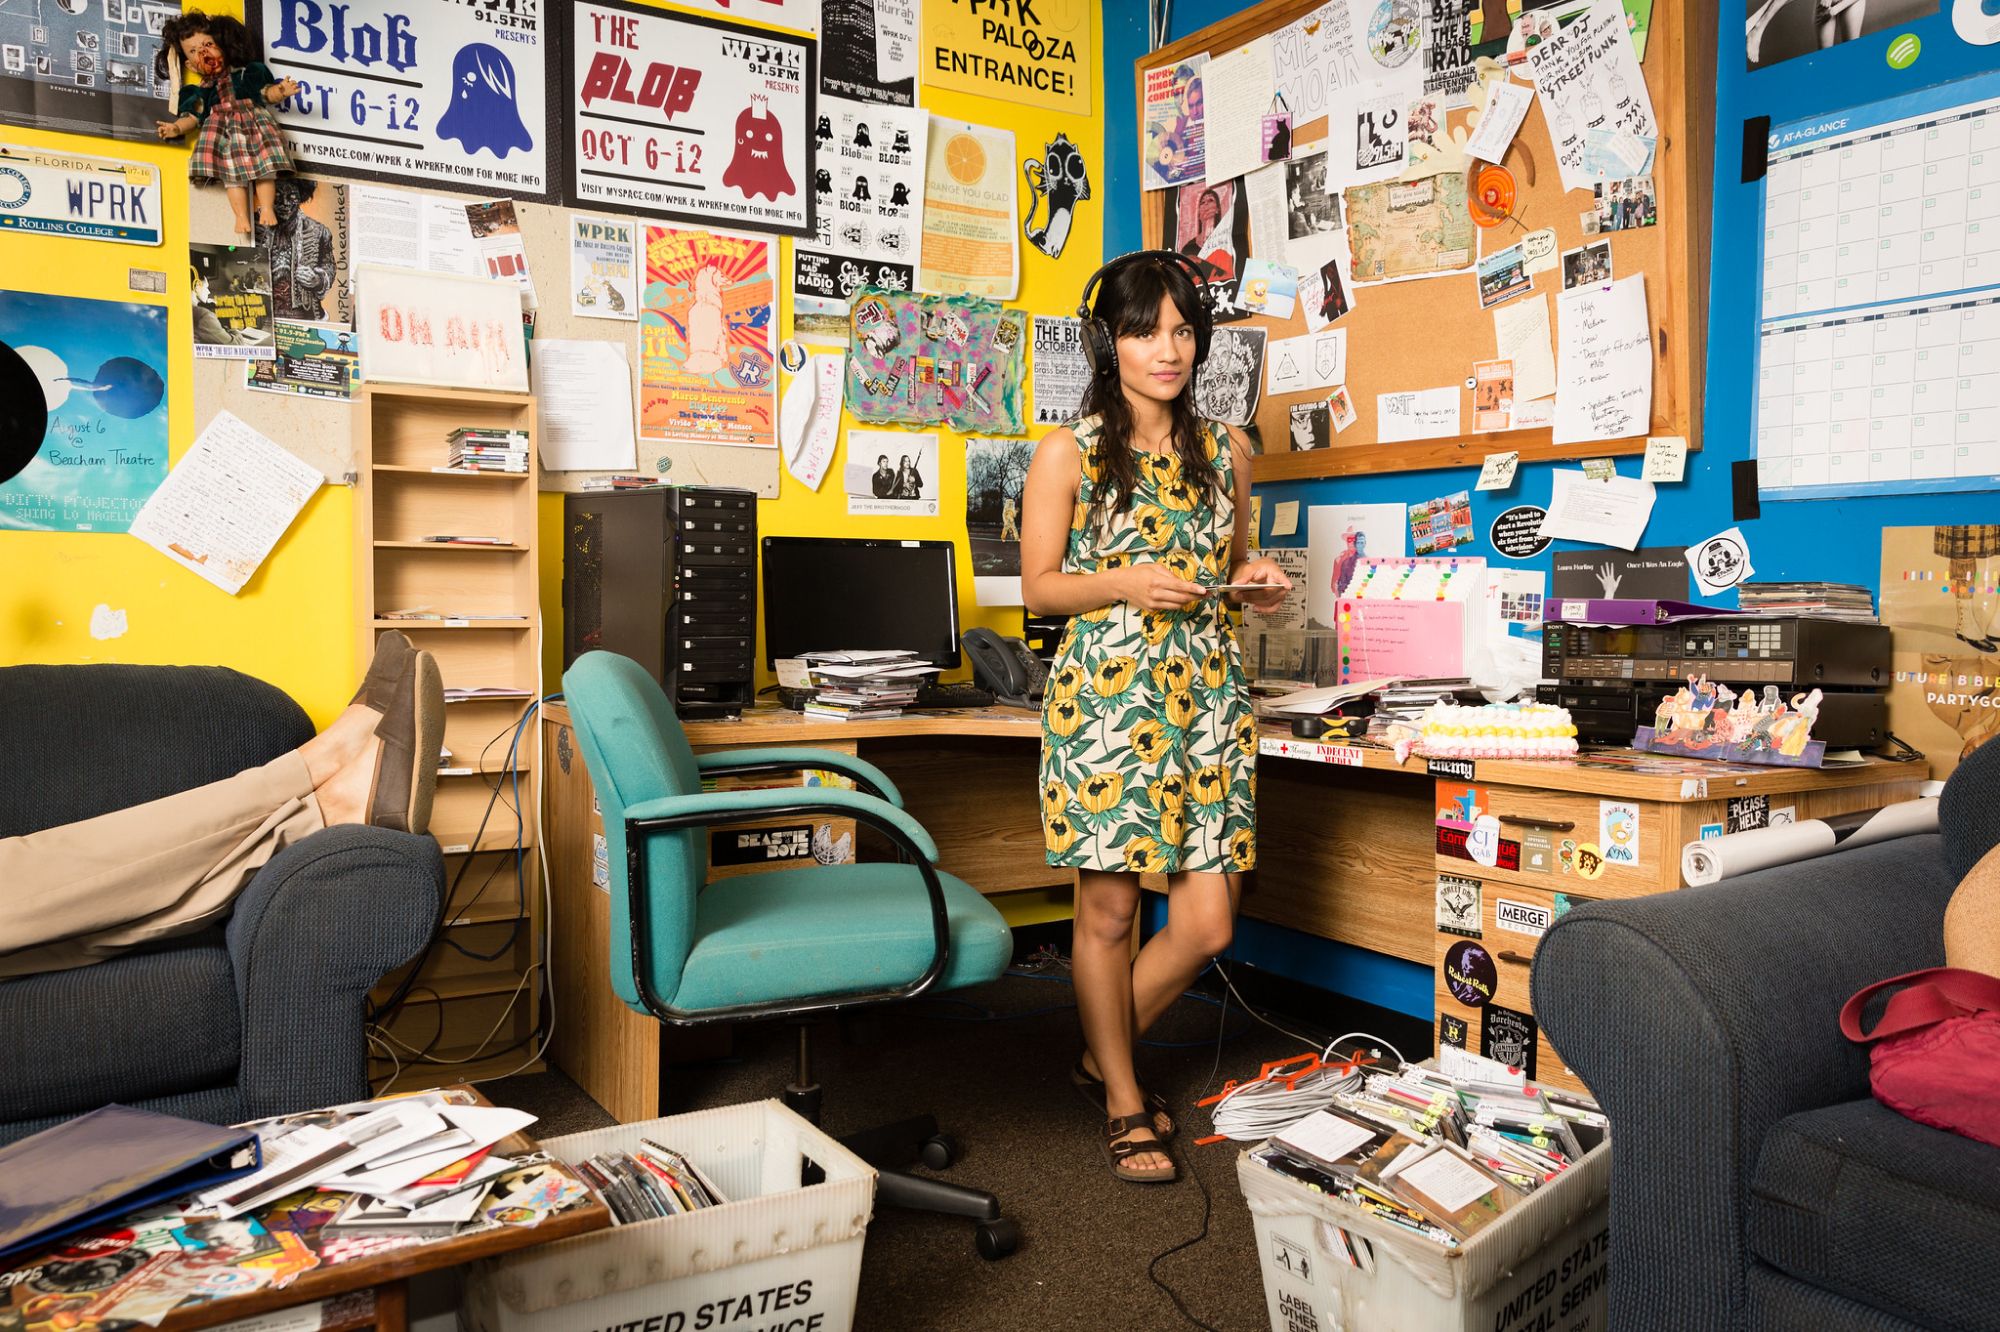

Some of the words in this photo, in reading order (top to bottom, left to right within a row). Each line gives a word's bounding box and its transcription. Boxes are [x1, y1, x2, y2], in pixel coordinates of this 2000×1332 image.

[475, 9, 537, 31] 91.5FM
[878, 2, 914, 20] Hurrah
[271, 0, 418, 73] Blob
[495, 28, 537, 46] PRESENTS
[590, 12, 639, 50] THE
[882, 29, 898, 39] WPRK
[1431, 25, 1459, 43] THE
[982, 20, 1077, 63] PALOOZA
[1432, 42, 1442, 53] IN
[1446, 35, 1472, 50] BASE
[1273, 33, 1318, 79] ME
[1530, 36, 1569, 68] DEAR
[1535, 55, 1564, 76] THANK
[1567, 41, 1581, 56] YOU
[1580, 34, 1593, 47] FOR
[749, 62, 799, 81] 91.5FM
[935, 46, 1075, 97] ENTRANCE!
[1539, 73, 1554, 86] OUR
[1554, 62, 1569, 77] NEW
[581, 52, 702, 122] BLOB
[765, 80, 799, 94] PRESENTS
[1147, 85, 1186, 103] CONTEST
[1431, 80, 1458, 91] LISTEN
[351, 89, 419, 132] 6-12
[1782, 117, 1848, 143] AT-A-GLANCE
[581, 129, 635, 166] OCT
[645, 138, 702, 174] 6-12
[879, 152, 900, 164] BLOB
[1560, 139, 1587, 166] DON'T
[35, 156, 93, 171] FLORIDA
[303, 143, 402, 168] MYSPACE.COM/WPRK
[405, 158, 412, 168] &
[414, 159, 474, 177] WPRKFM.COM
[476, 167, 493, 180] FOR
[495, 170, 518, 185] MORE
[521, 173, 540, 187] INFO
[66, 177, 147, 224] WPRK
[581, 182, 603, 195] VISIT
[606, 187, 687, 206] MYSPACE.COM/WPRK
[690, 199, 696, 208] &
[698, 199, 747, 214] WPRKFM.COM
[749, 205, 764, 216] FOR
[765, 208, 783, 219] MORE
[786, 210, 802, 221] INFO
[963, 187, 981, 199] YOU
[984, 191, 1009, 202] GLAD
[333, 183, 350, 271] Unearthed
[577, 222, 629, 243] WPRK
[648, 241, 692, 268] FOX
[696, 239, 746, 260] FEST
[798, 253, 829, 264] PUTTING
[668, 257, 697, 274] 2015
[801, 264, 818, 273] RAD
[798, 275, 834, 288] RADIO
[336, 278, 350, 323] WPRK
[1580, 301, 1596, 316] High
[644, 324, 676, 338] April
[1034, 318, 1049, 326] WPRK
[1035, 325, 1060, 342] THE
[1581, 334, 1599, 346] Low
[1034, 341, 1077, 353] OCTOBER
[671, 390, 699, 401] Marco
[1318, 401, 1328, 410] UP
[49, 416, 91, 441] August
[97, 419, 106, 434] 6
[71, 438, 84, 448] @
[49, 449, 106, 466] Beacham
[108, 448, 156, 466] Theatre
[5, 493, 56, 507] DIRTY
[63, 509, 79, 520] LO
[1518, 512, 1533, 521] hard
[1497, 522, 1511, 530] start
[1498, 530, 1514, 538] when
[1514, 529, 1528, 538] your
[1497, 538, 1507, 546] six
[1507, 537, 1518, 545] feet
[1518, 535, 1534, 544] from
[1626, 561, 1642, 569] Once
[1668, 561, 1685, 569] Eagle
[1317, 745, 1360, 759] INDECENT
[1325, 756, 1352, 766] MEDIA
[1732, 795, 1767, 818] PLEASE
[1738, 812, 1762, 832] HELP
[737, 829, 809, 848] BEASTIE
[766, 842, 809, 858] BOYS
[1502, 906, 1545, 926] MERGE
[1500, 920, 1541, 935] RECORD
[1489, 1013, 1530, 1034] Dorchester
[1495, 1268, 1557, 1332] UNITED
[1560, 1227, 1610, 1283] STATE
[693, 1279, 813, 1331] STATES
[1278, 1289, 1317, 1319] LABEL
[1279, 1303, 1320, 1332] OTHER
